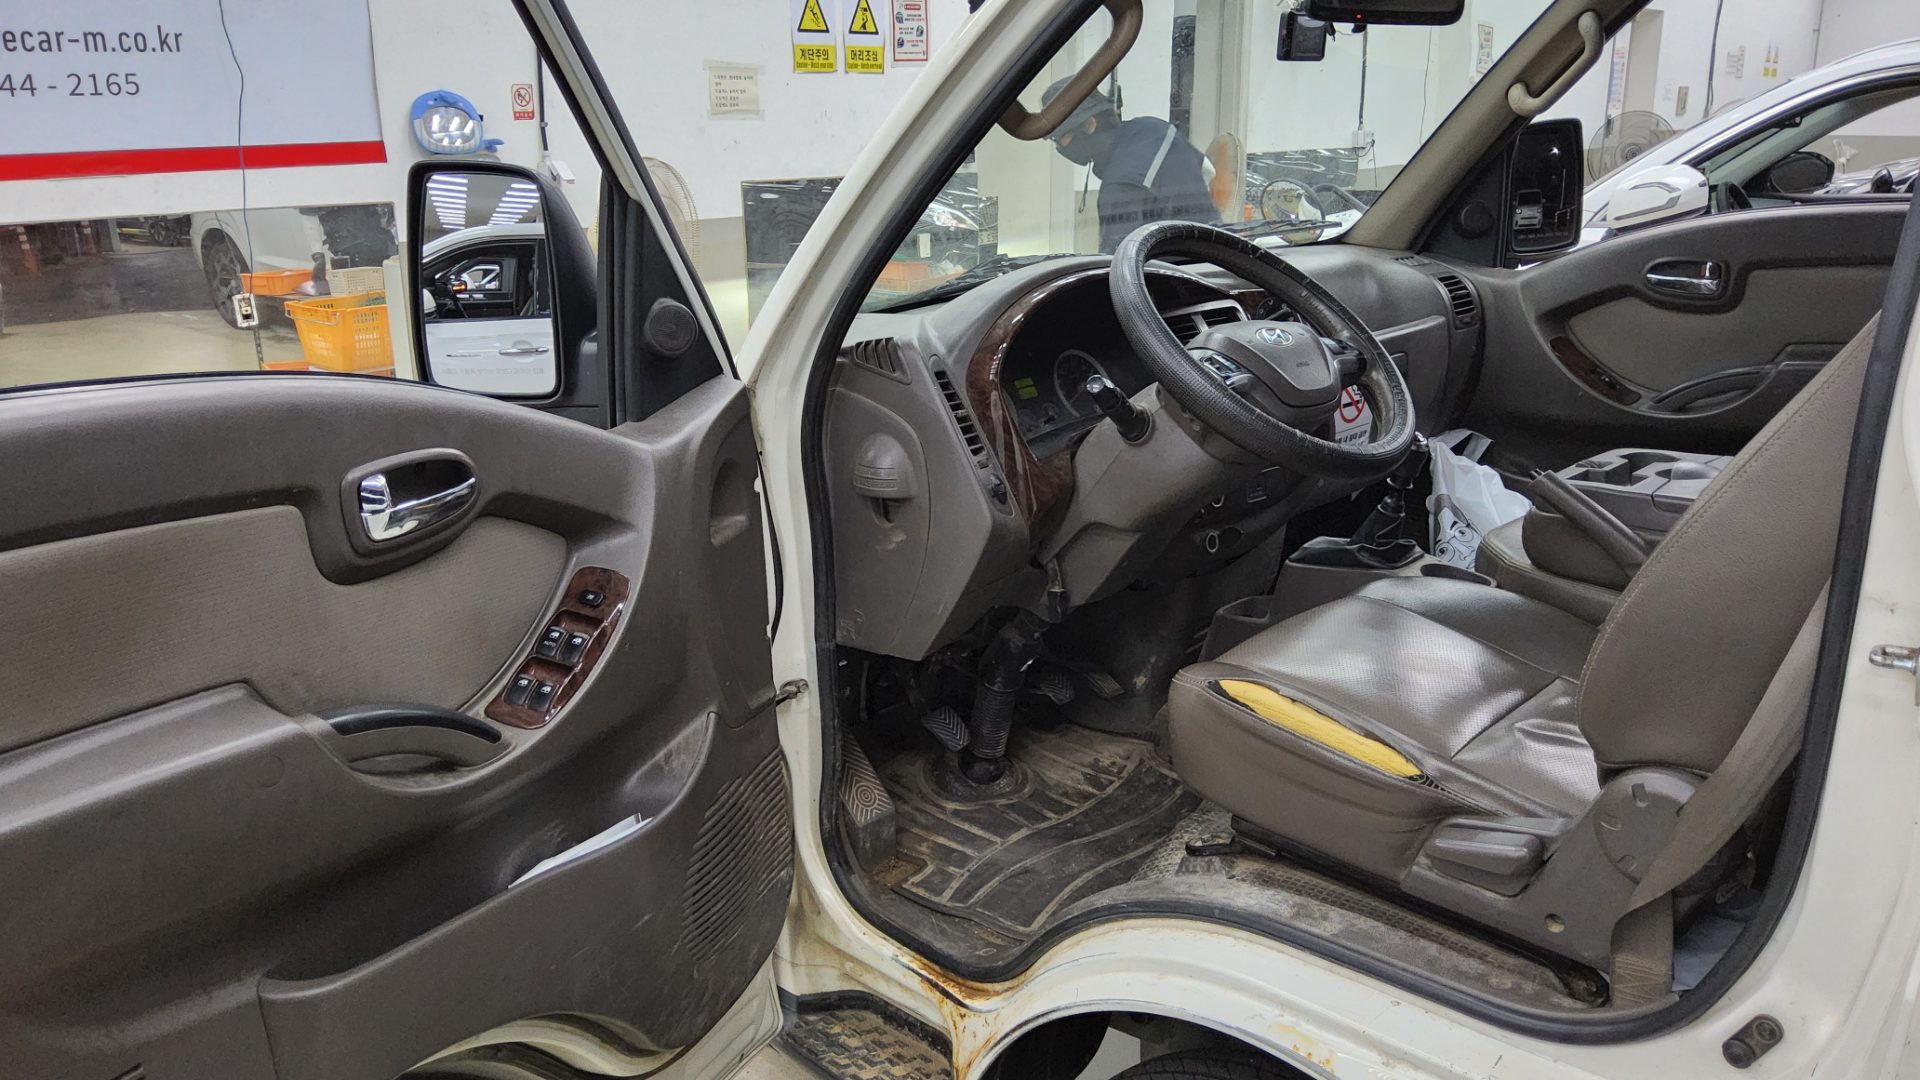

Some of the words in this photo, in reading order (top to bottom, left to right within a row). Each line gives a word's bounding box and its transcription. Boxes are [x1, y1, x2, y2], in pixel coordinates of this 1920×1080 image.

[2, 25, 183, 53] ecar-m.co.kr
[800, 48, 829, 60] 계단주의
[850, 49, 878, 62] 머리조심
[0, 74, 37, 97] 44
[66, 73, 140, 96] 2165
